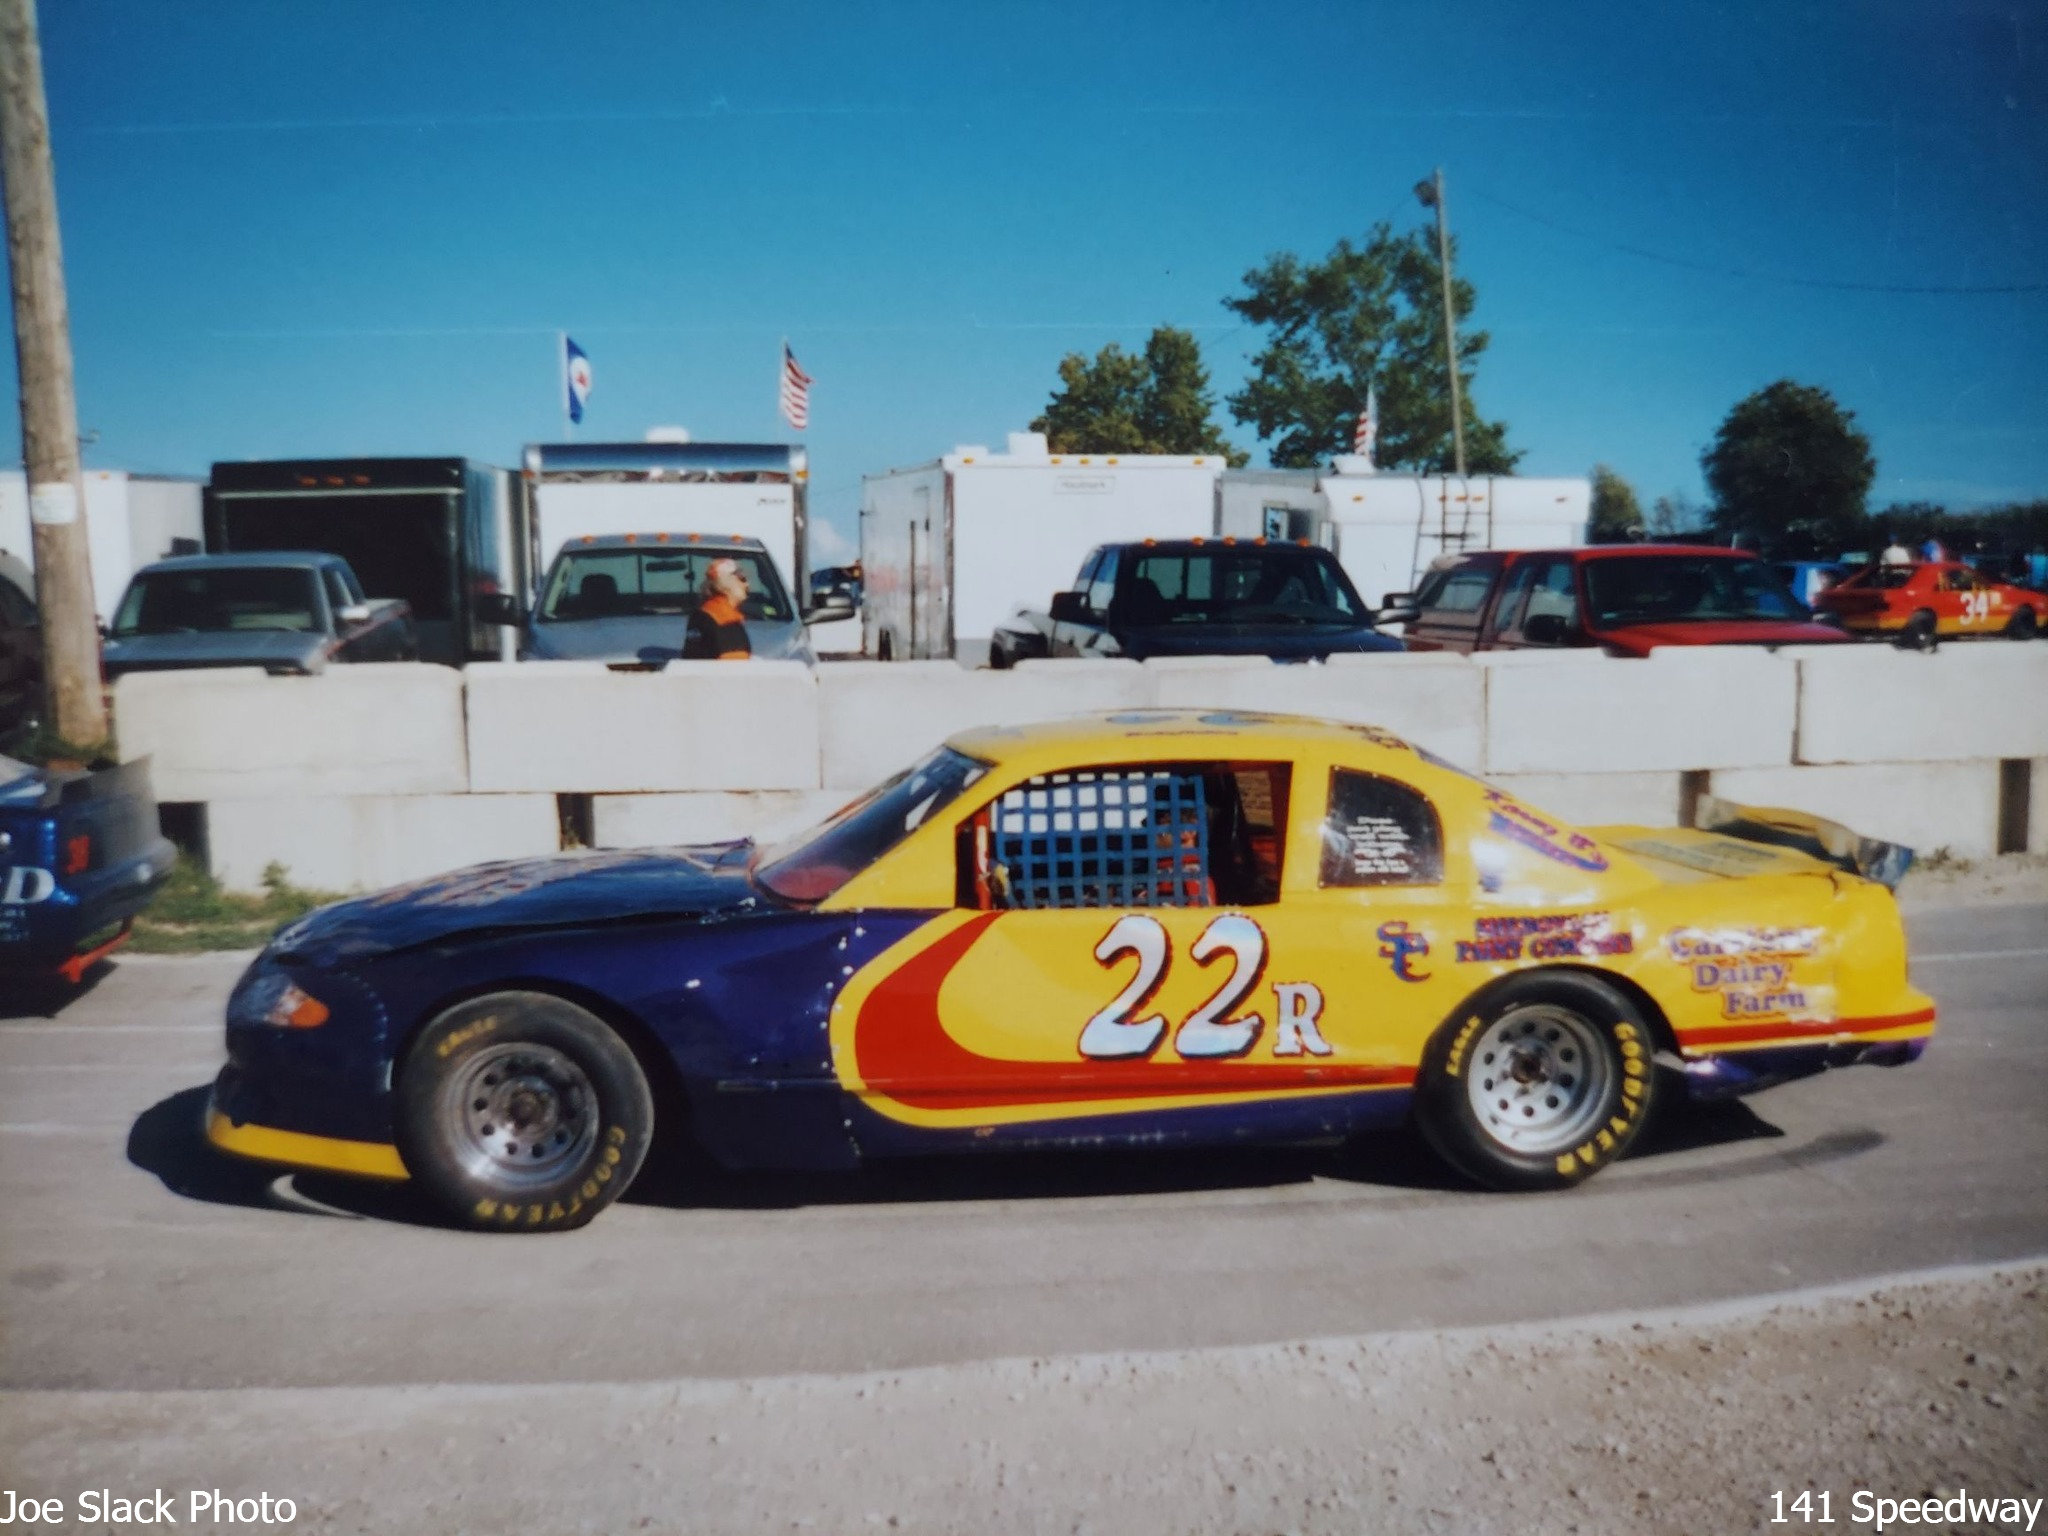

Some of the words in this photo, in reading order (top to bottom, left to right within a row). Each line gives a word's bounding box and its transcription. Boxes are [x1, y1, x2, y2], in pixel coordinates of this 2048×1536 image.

[1960, 590, 1989, 625] 34
[0, 866, 55, 904] D
[1697, 964, 1783, 989] Dairy
[1727, 992, 1806, 1013] Farm
[1556, 1021, 1645, 1177] GOODYEAR
[474, 1125, 627, 1225] GOODYEAR
